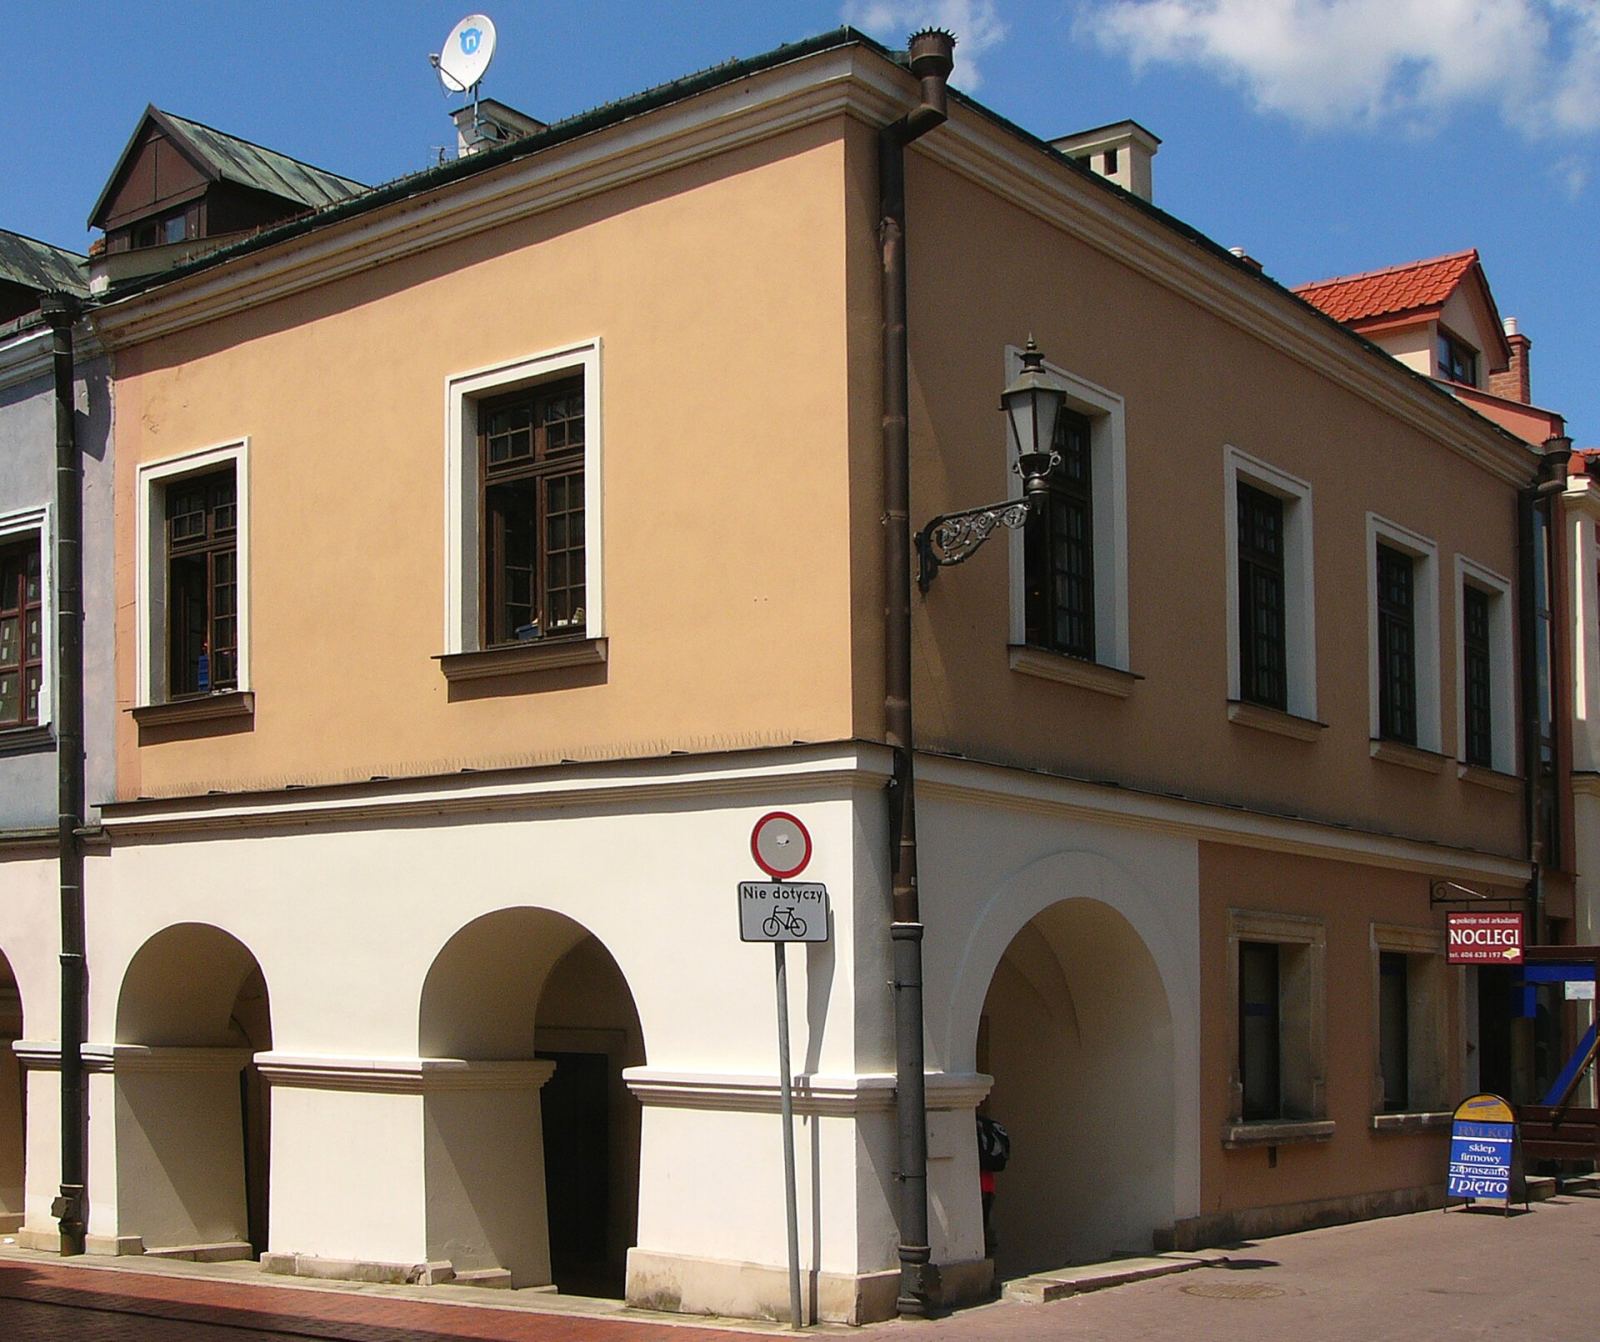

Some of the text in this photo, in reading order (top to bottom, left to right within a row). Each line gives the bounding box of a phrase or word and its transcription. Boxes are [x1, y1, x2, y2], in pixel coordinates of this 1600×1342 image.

[743, 886, 822, 903] Nie dotyczy
[1478, 917, 1490, 925] nad
[1449, 929, 1519, 945] NOCLEGI
[1468, 1143, 1496, 1154] sklep
[1460, 1152, 1502, 1165] firmowy
[1450, 1165, 1509, 1177] zapraszamy
[1457, 1178, 1508, 1195] piętro
